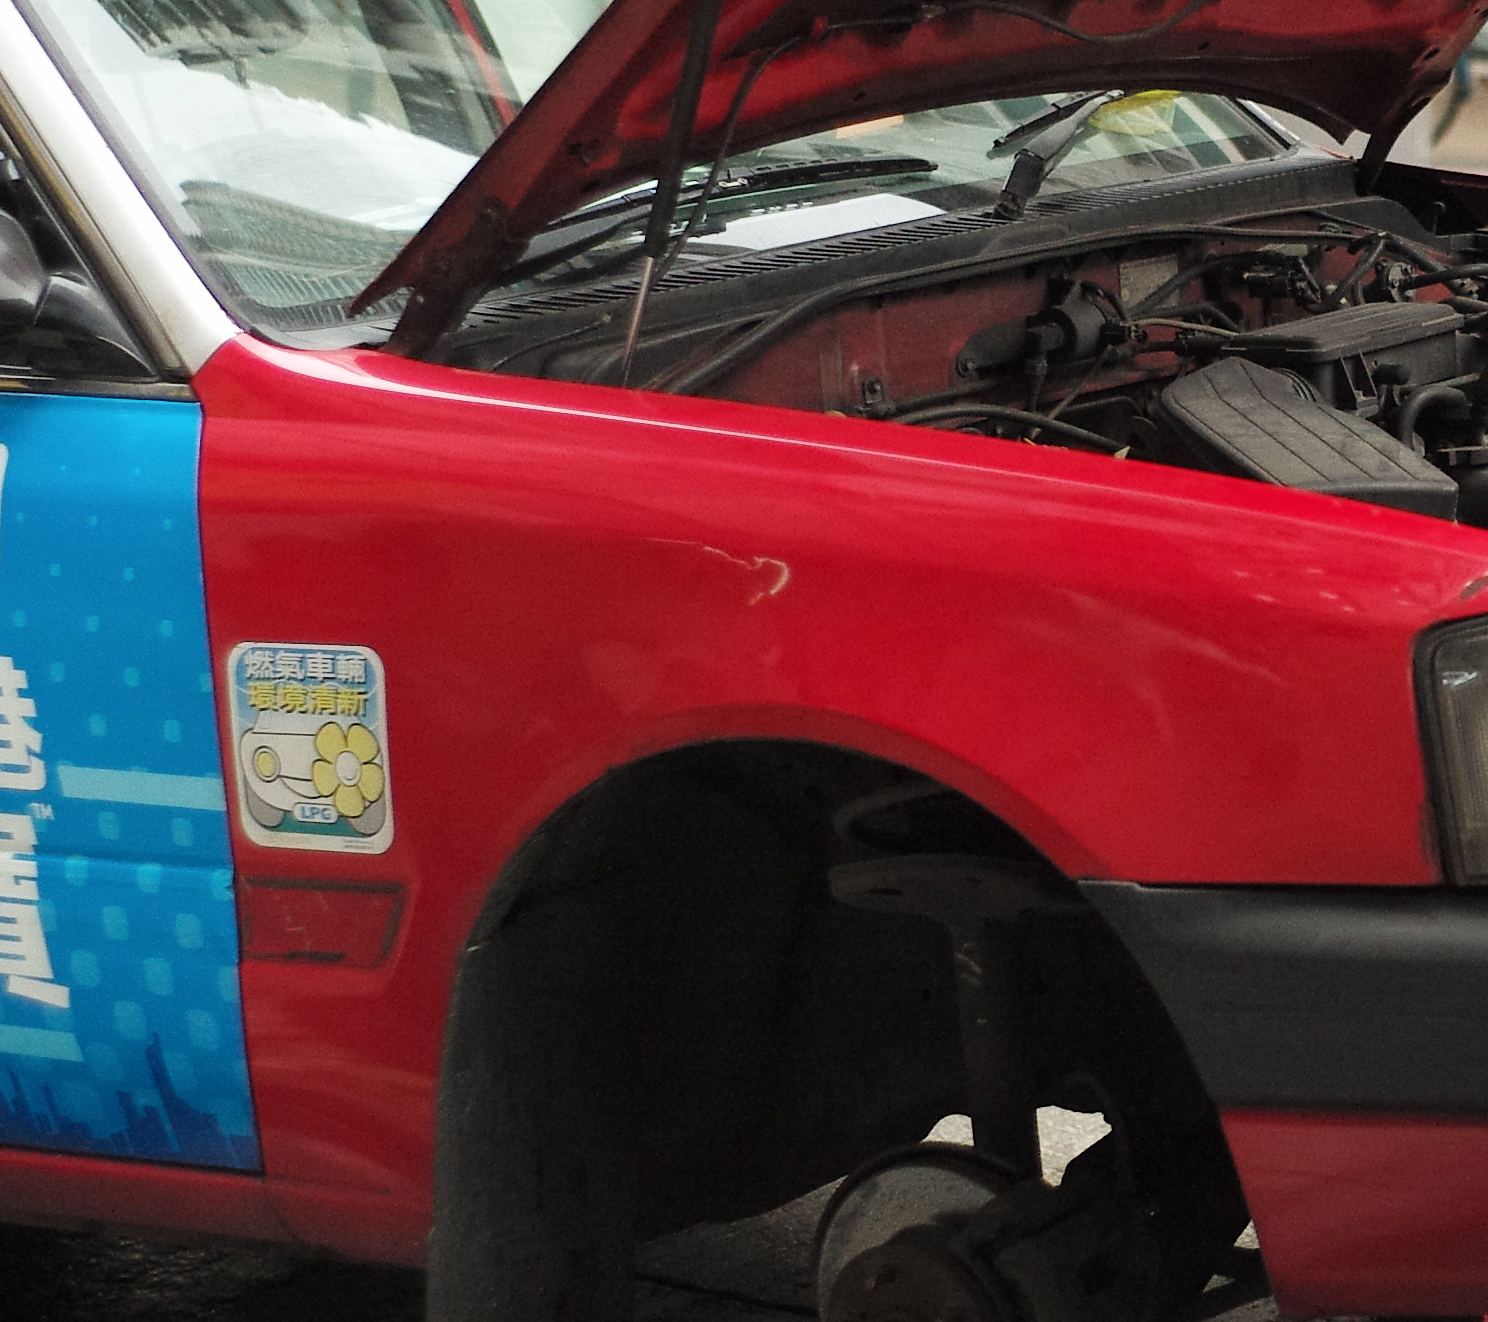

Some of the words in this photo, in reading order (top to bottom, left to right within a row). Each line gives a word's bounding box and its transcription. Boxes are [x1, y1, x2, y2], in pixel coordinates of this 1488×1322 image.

[245, 650, 368, 684] 燃氣車輛
[248, 681, 368, 717] 環境清新
[299, 806, 333, 822] LPG
